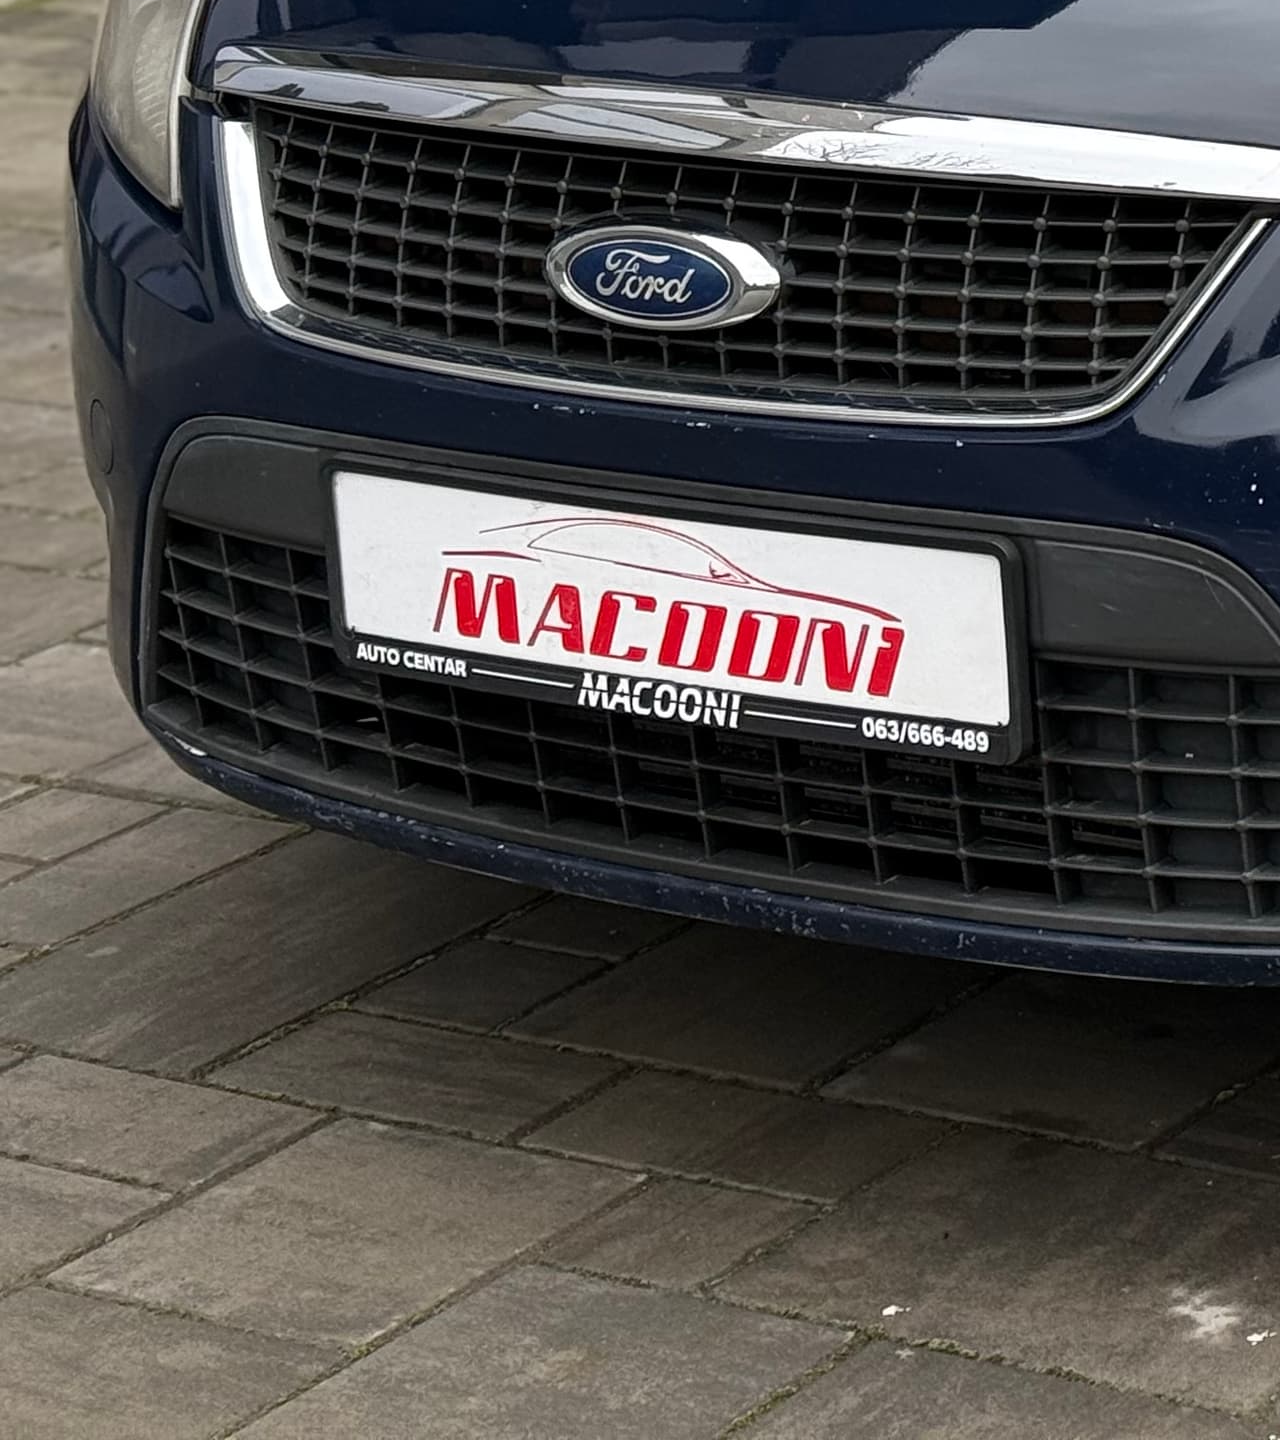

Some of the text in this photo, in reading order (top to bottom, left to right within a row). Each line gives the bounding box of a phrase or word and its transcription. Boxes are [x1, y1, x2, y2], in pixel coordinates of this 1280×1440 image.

[596, 248, 695, 303] Ford
[355, 642, 467, 678] AUTO CENTAR
[578, 671, 742, 730] MACOONI
[861, 716, 990, 753] 063/666-489
